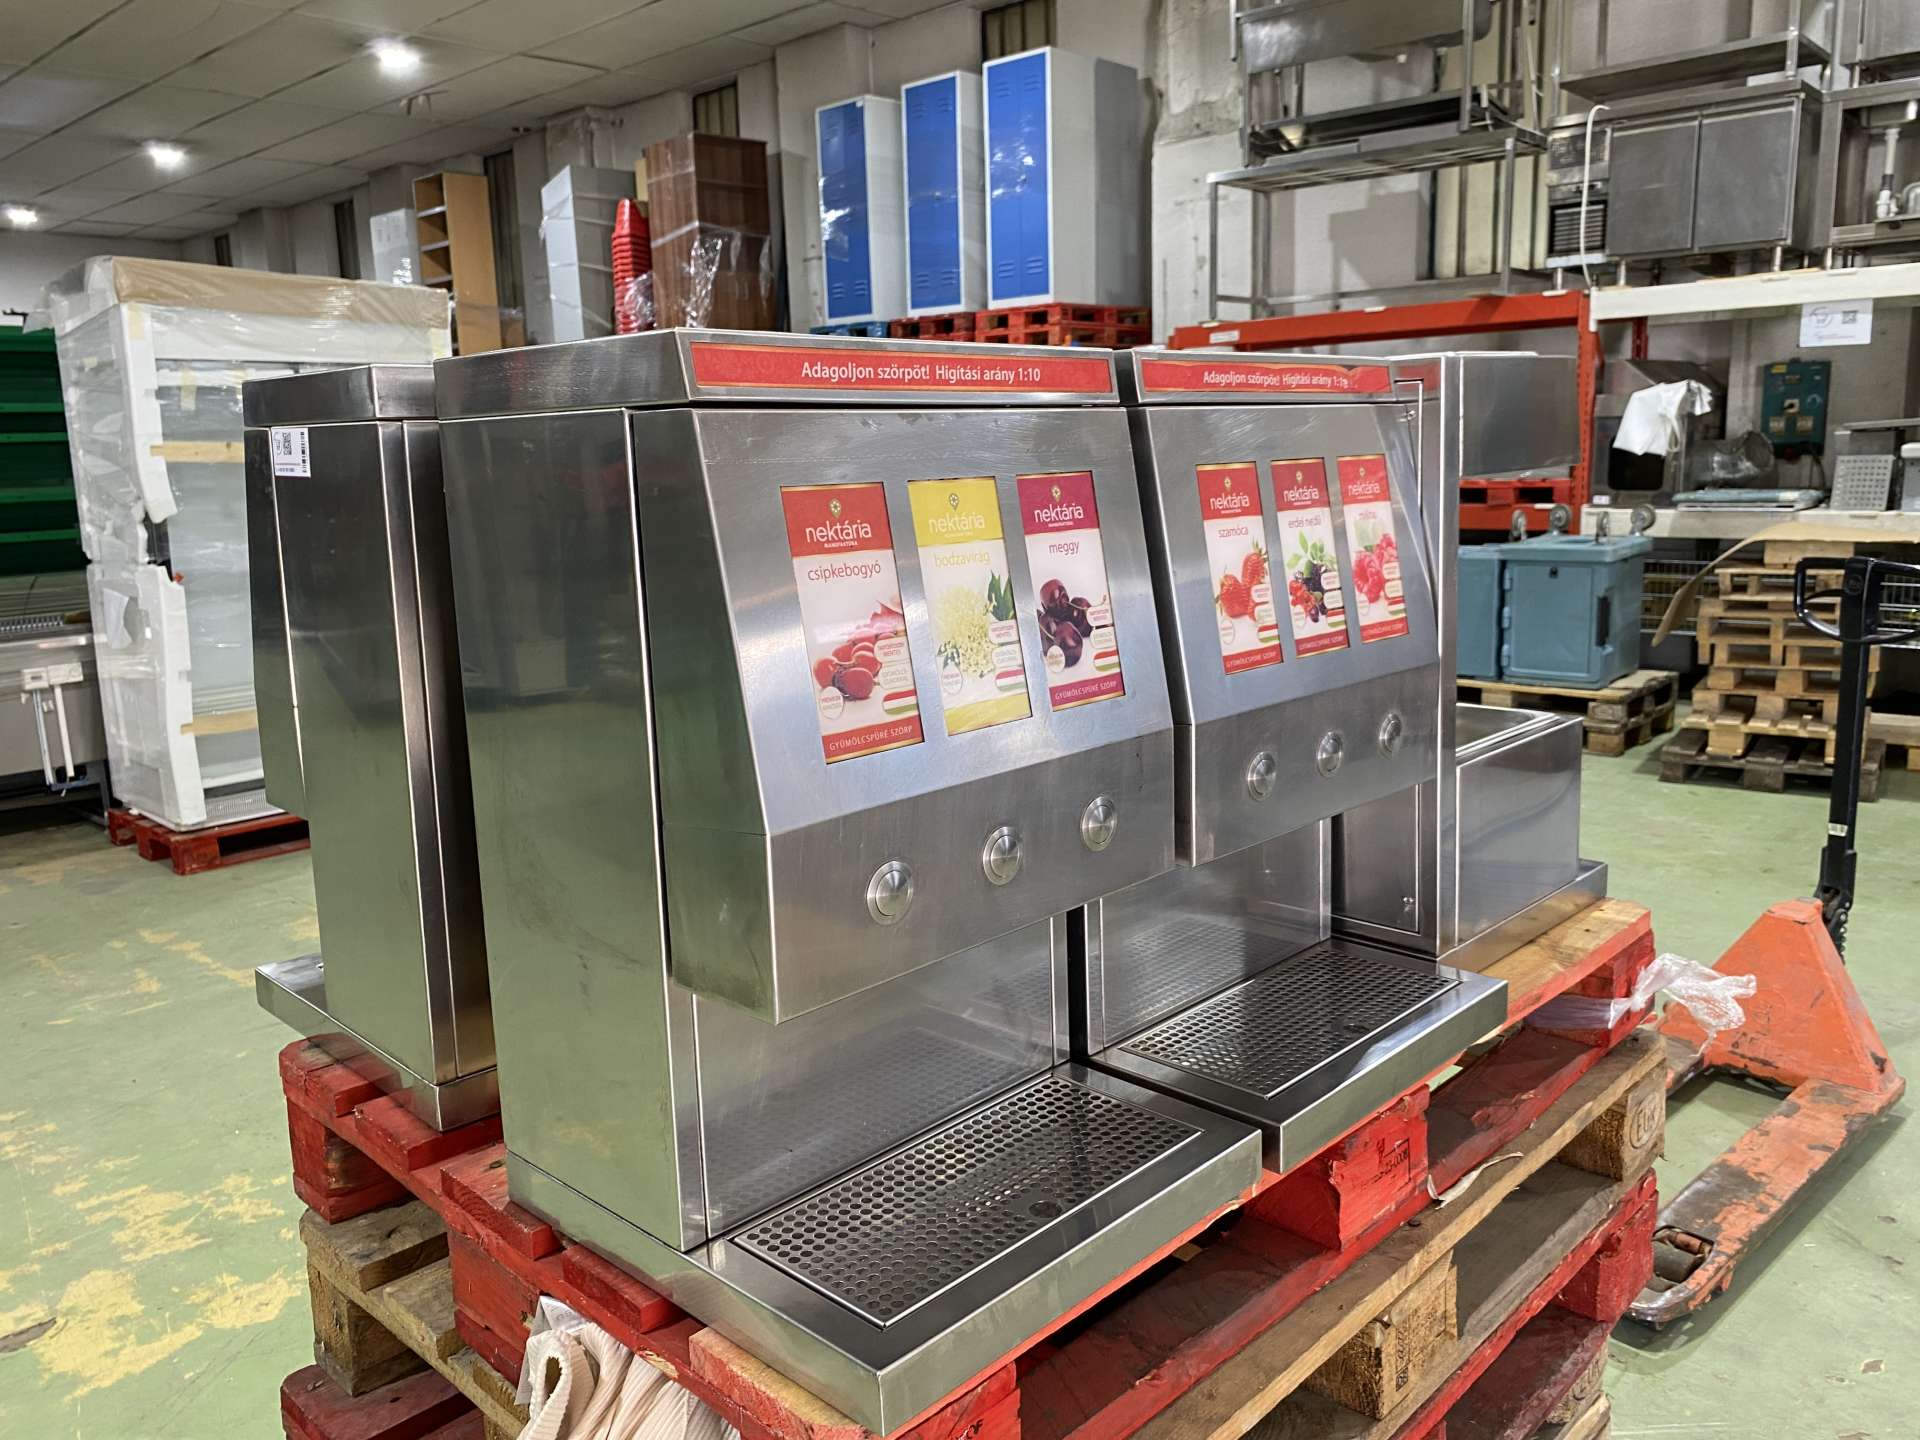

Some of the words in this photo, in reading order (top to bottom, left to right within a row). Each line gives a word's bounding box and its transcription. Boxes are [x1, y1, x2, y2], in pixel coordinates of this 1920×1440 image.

[801, 361, 875, 384] Adagoljon
[877, 363, 930, 384] szörpöt!
[935, 365, 982, 384] Higítási
[983, 367, 1015, 384] arány
[1017, 367, 1041, 382] 1:10
[1203, 371, 1246, 386] Adagoljon
[1283, 485, 1319, 502] nektária
[1347, 480, 1381, 497] nektária
[1210, 492, 1250, 510] nektária
[928, 511, 985, 533] nektária
[1034, 502, 1084, 523] nektária
[805, 519, 872, 543] nektária
[1048, 540, 1080, 556] meggy
[808, 560, 881, 583] csipkebogyó
